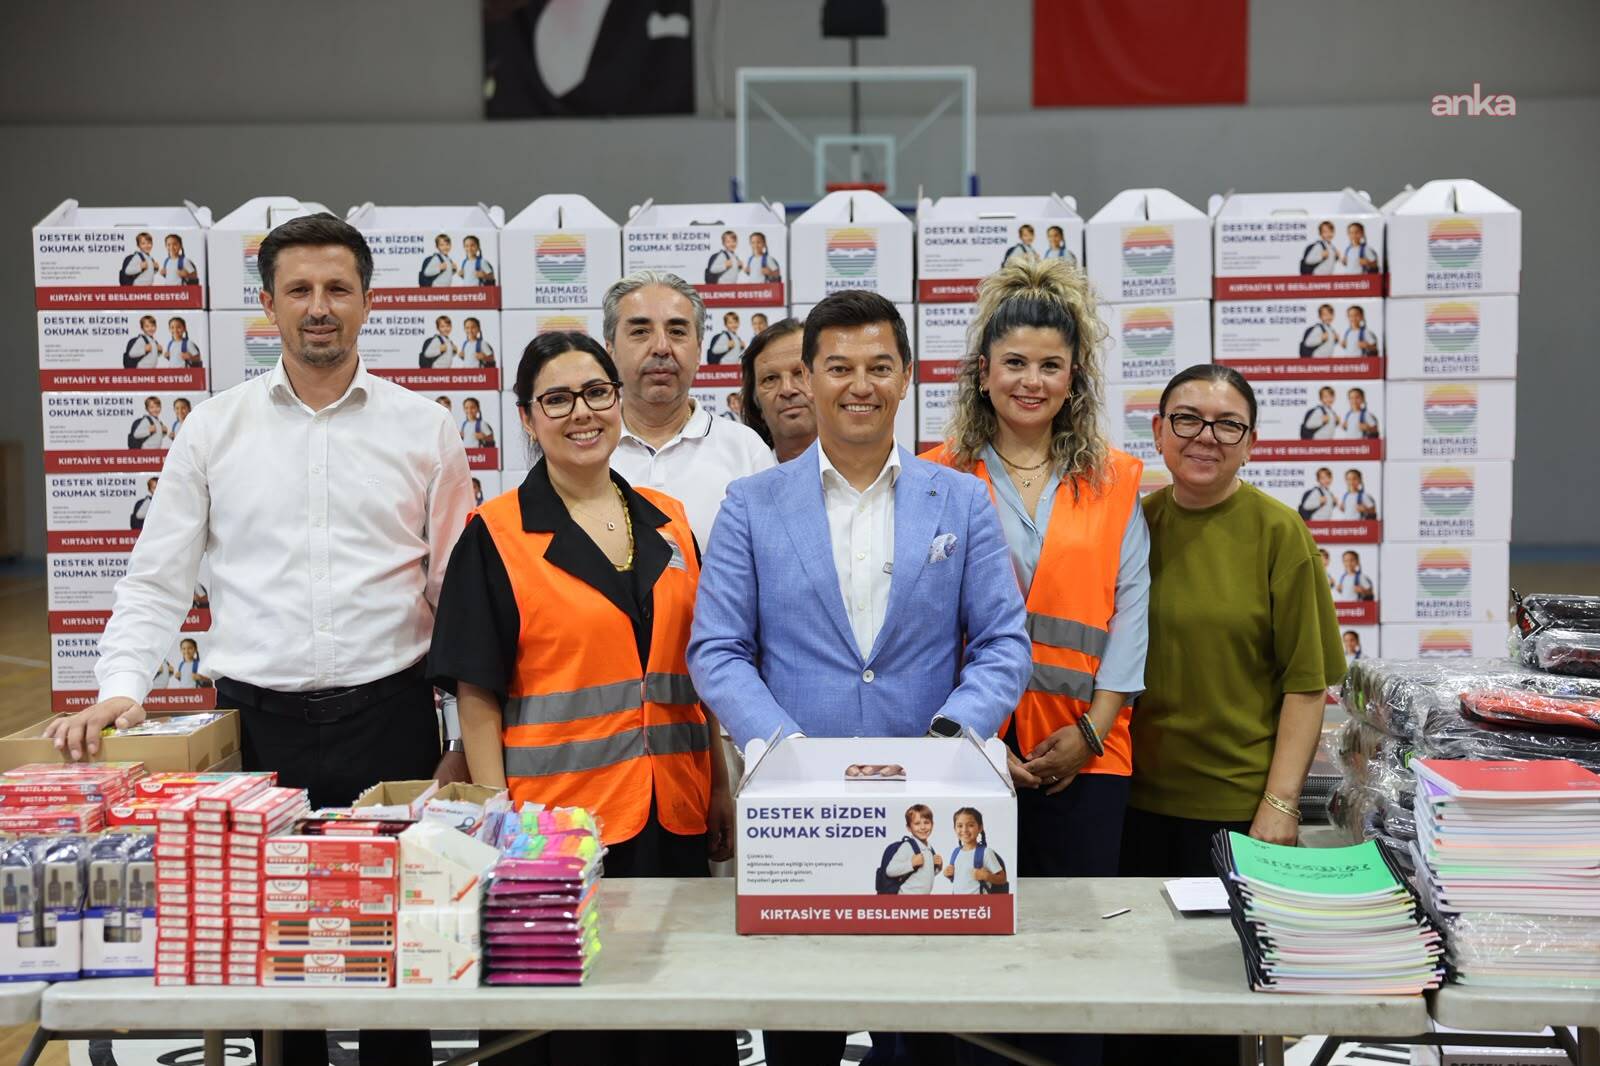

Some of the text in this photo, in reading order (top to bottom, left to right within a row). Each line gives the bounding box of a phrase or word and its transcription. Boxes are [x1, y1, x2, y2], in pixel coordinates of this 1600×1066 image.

[924, 226, 1007, 235] DESTEK BİZDEN
[1222, 224, 1263, 232] DESTEK
[40, 232, 125, 242] DESTEK BİZDEN
[385, 234, 424, 243] BİZDEN
[672, 232, 710, 240] BİZDEN
[972, 236, 1008, 245] SİZDEN
[1222, 234, 1266, 243] OKUMAK
[40, 244, 125, 253] OKUMAK SİZDEN
[388, 246, 424, 254] SİZDEN
[675, 243, 710, 251] SİZDEN
[50, 292, 92, 302] KIRTASİYE
[154, 291, 190, 300] DESTEĞİ
[452, 292, 486, 301] DESTEĞİ
[738, 289, 772, 298] DESTEĞİ
[89, 315, 129, 324] BİZDEN
[387, 316, 425, 325] BİZDEN
[1222, 317, 1265, 325] OKUMAK
[92, 326, 129, 335] SİZDEN
[389, 327, 425, 335] SİZDEN
[54, 374, 192, 385] KIRTASİYE VE BESLENME DESTEĞİ
[452, 374, 486, 383] DESTEĞİ
[94, 396, 133, 405] BİZDEN
[49, 408, 134, 417] OKUMAK SİZDEN
[58, 456, 101, 465] KIRTASİYE
[97, 478, 136, 486] BİZDEN
[100, 488, 136, 497] SİZDEN
[61, 536, 104, 545] KIRTASİYE
[62, 617, 104, 626] KIRTASİYE
[168, 694, 203, 703] DESTEĞİ
[746, 804, 886, 820] DESTEK BİZDEN
[746, 823, 886, 839] OKUMAK SİZDEN
[760, 905, 991, 920] KIRTASİYE VE BESLENME DESTEĞİ
